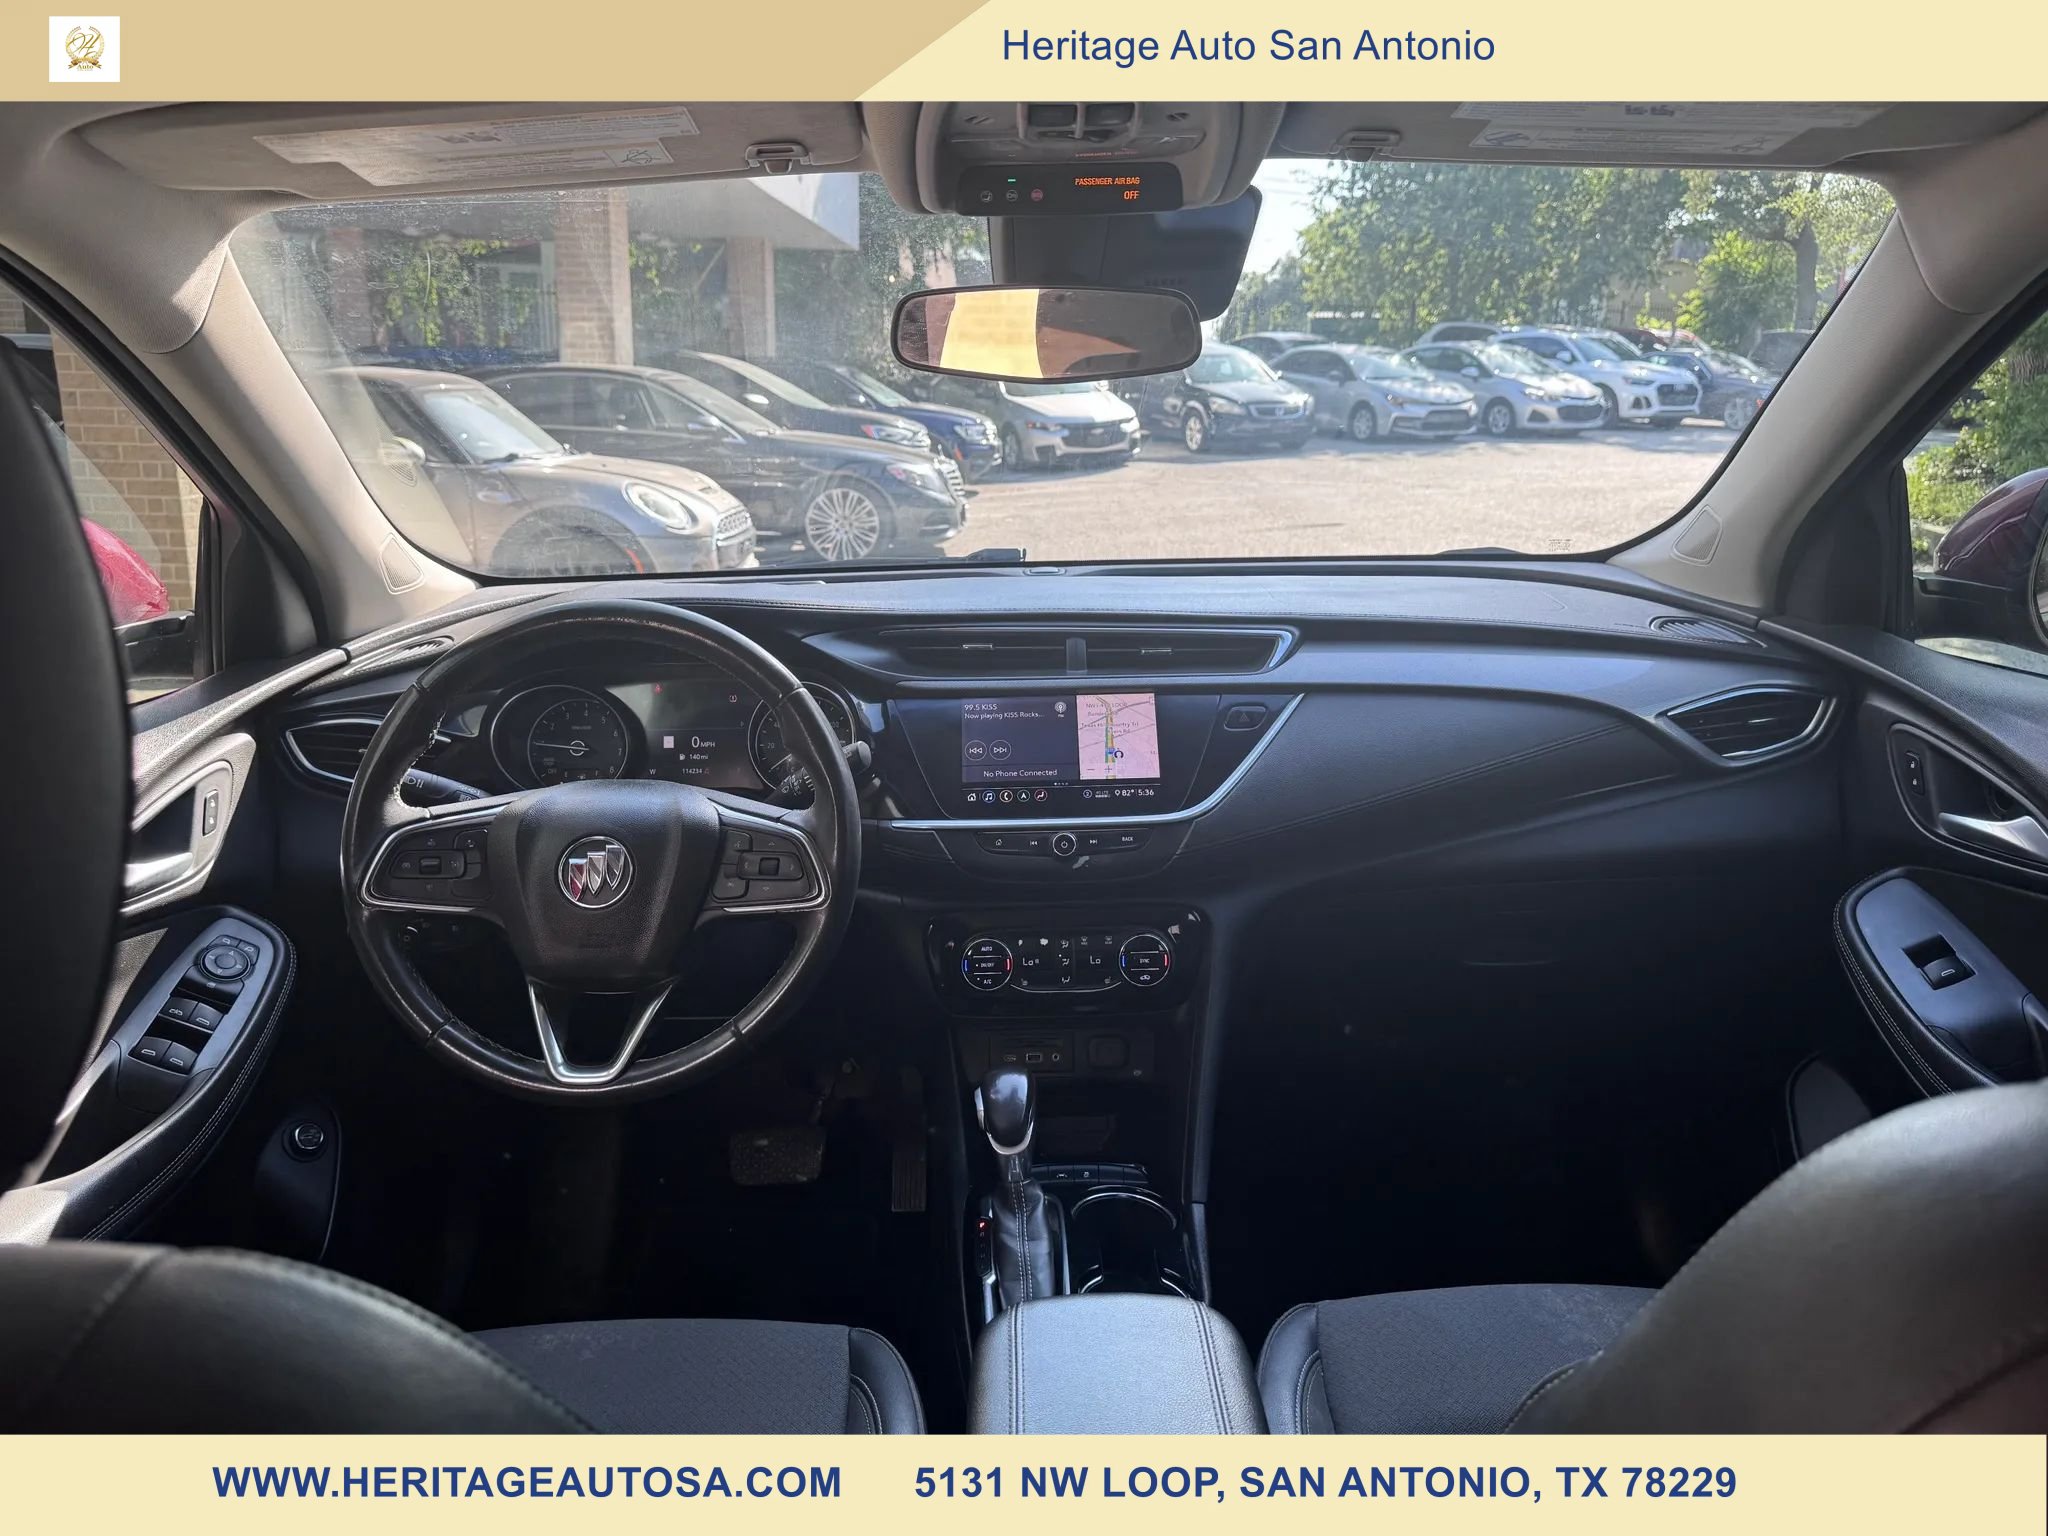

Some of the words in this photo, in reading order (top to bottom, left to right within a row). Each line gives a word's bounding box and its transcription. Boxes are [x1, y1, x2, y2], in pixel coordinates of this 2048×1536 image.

[1075, 178, 1113, 186] PASSENGER
[1114, 177, 1126, 185] AIR
[1127, 177, 1140, 185] BAG
[1123, 190, 1140, 200] OFF
[964, 703, 980, 711] 99.5
[981, 703, 998, 711] KISS
[980, 712, 1003, 720] playing
[691, 736, 700, 748] 0
[995, 769, 1018, 777] Phone
[1019, 769, 1058, 777] Connected
